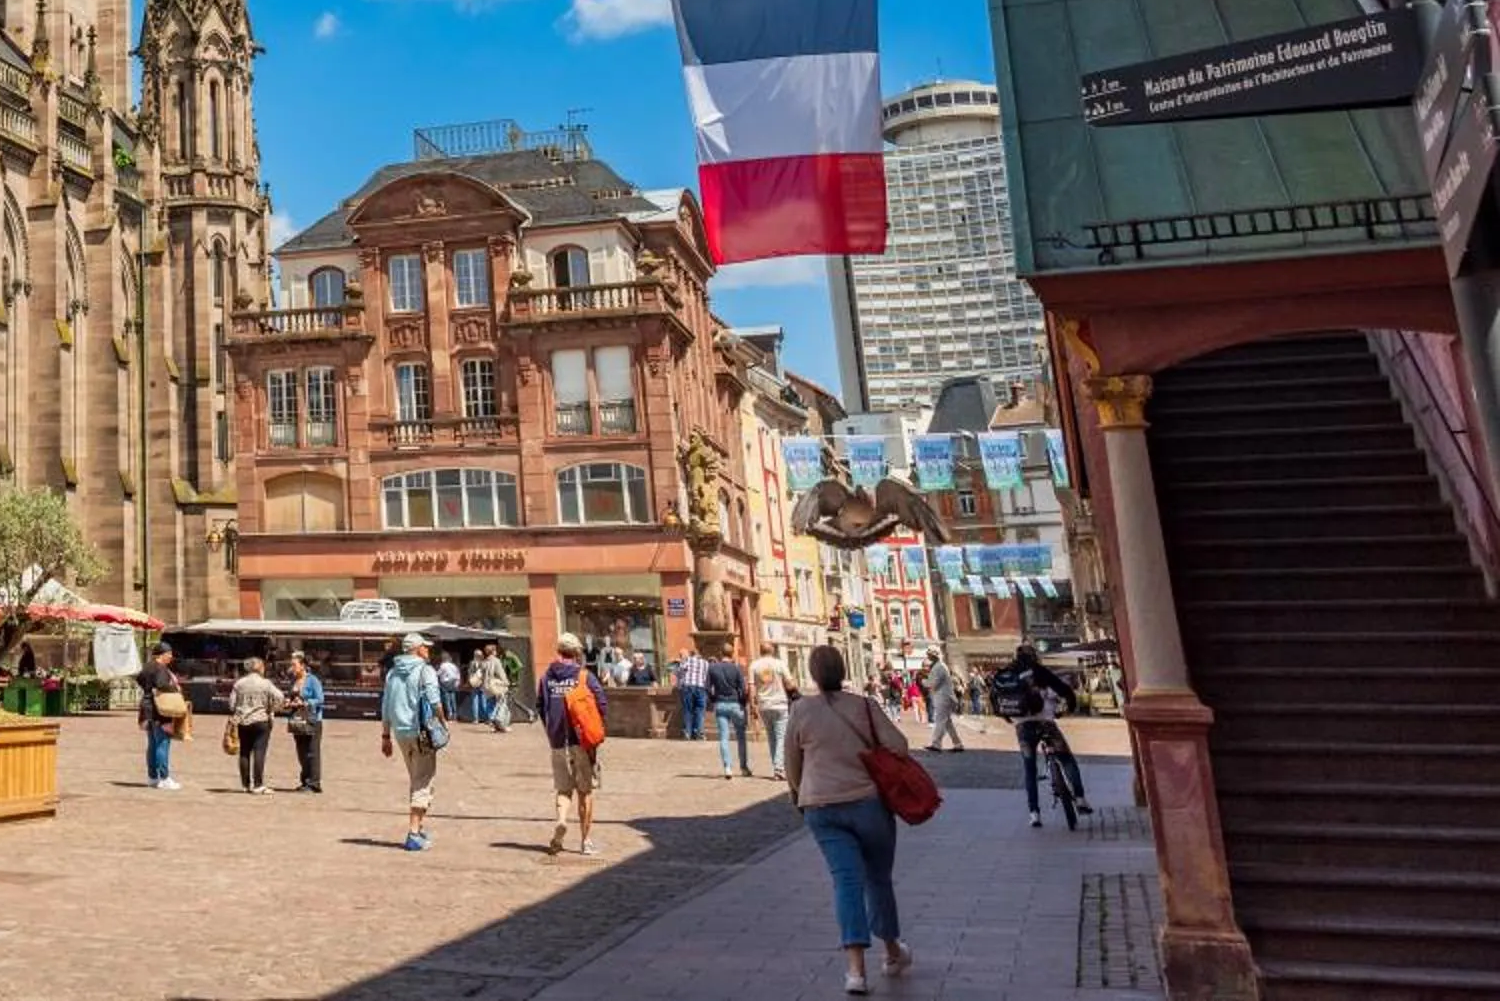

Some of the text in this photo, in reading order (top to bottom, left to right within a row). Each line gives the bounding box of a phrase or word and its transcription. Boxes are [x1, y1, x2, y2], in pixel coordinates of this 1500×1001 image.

[1143, 20, 1388, 97] Maison du Patrimoine Edouard Boeglin
